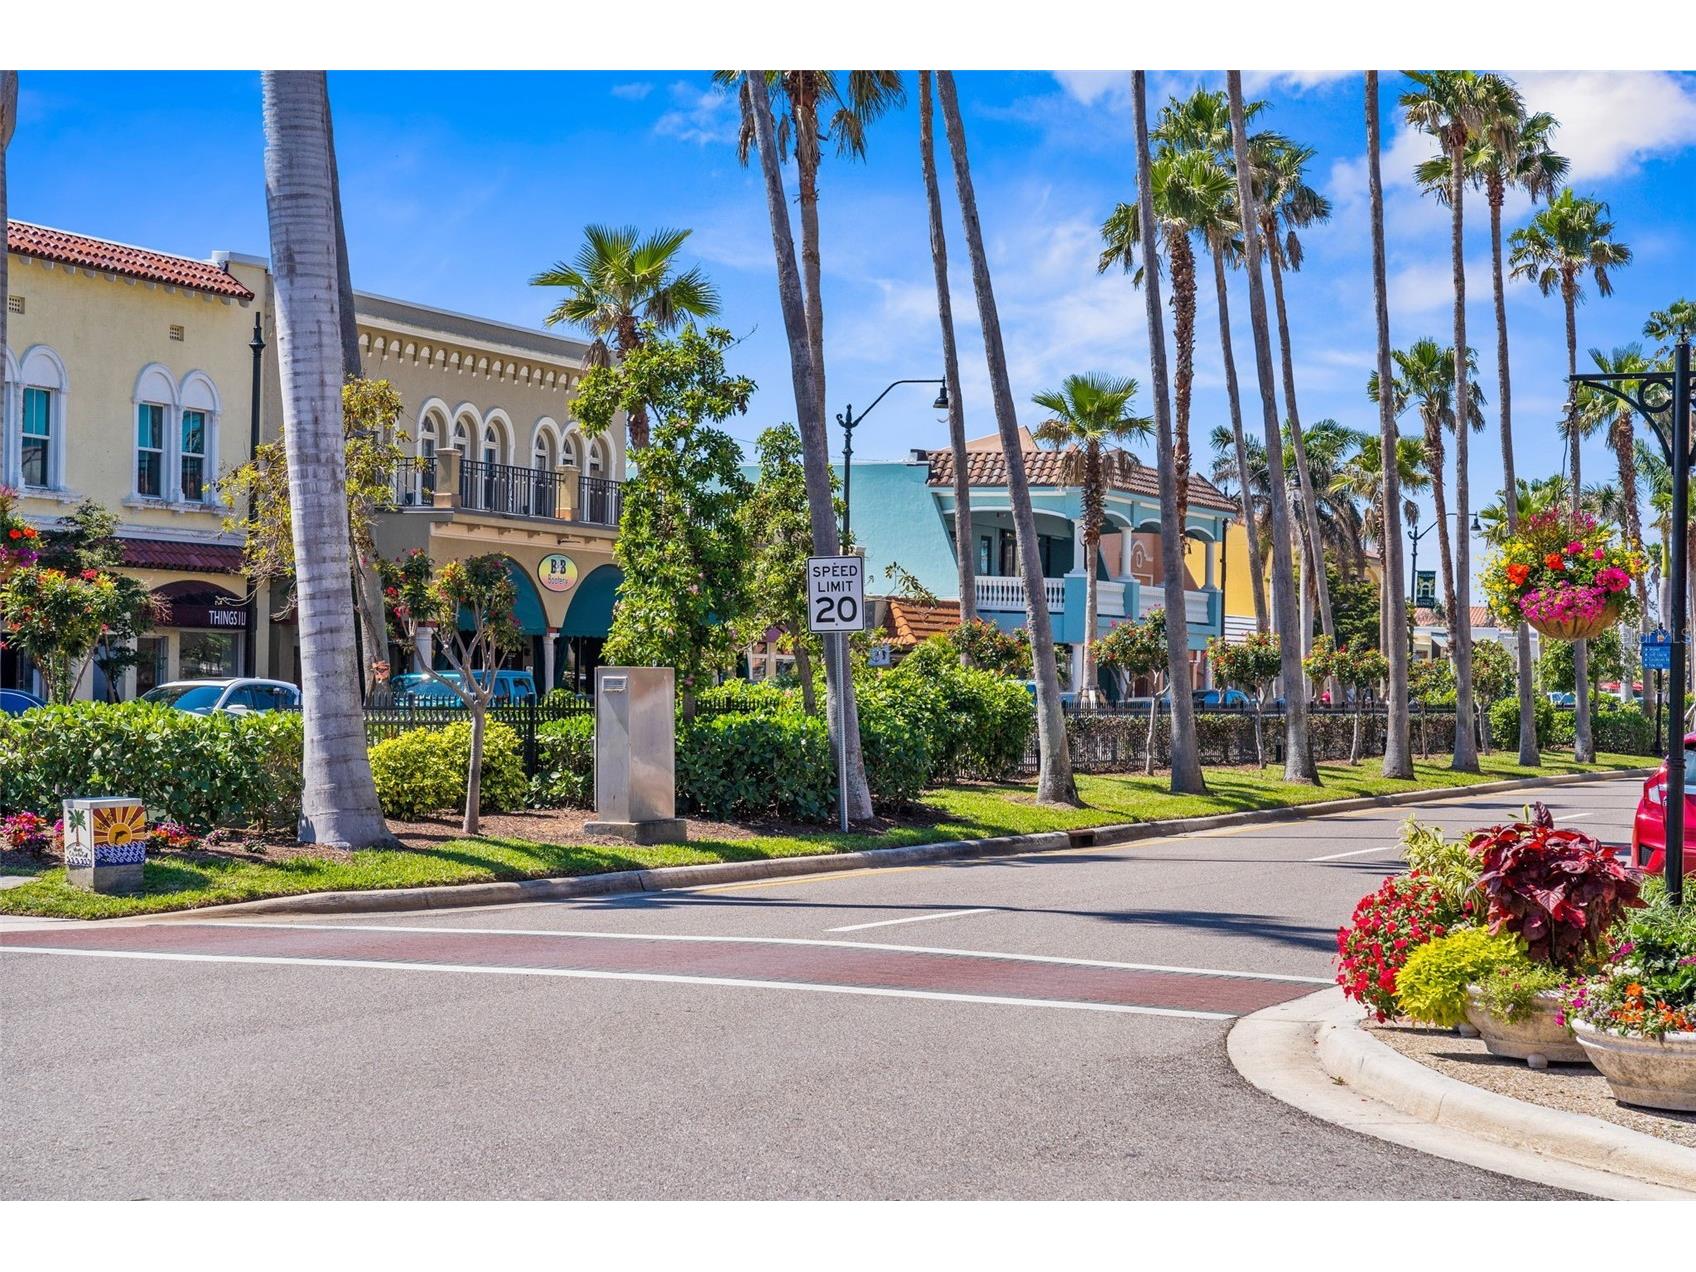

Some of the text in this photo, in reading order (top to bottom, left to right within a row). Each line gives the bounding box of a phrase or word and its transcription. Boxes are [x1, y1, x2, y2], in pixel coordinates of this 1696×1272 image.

[813, 565, 858, 577] SPEED
[817, 580, 853, 592] LIMIT
[815, 596, 857, 623] 20
[208, 610, 238, 625] THINGS
